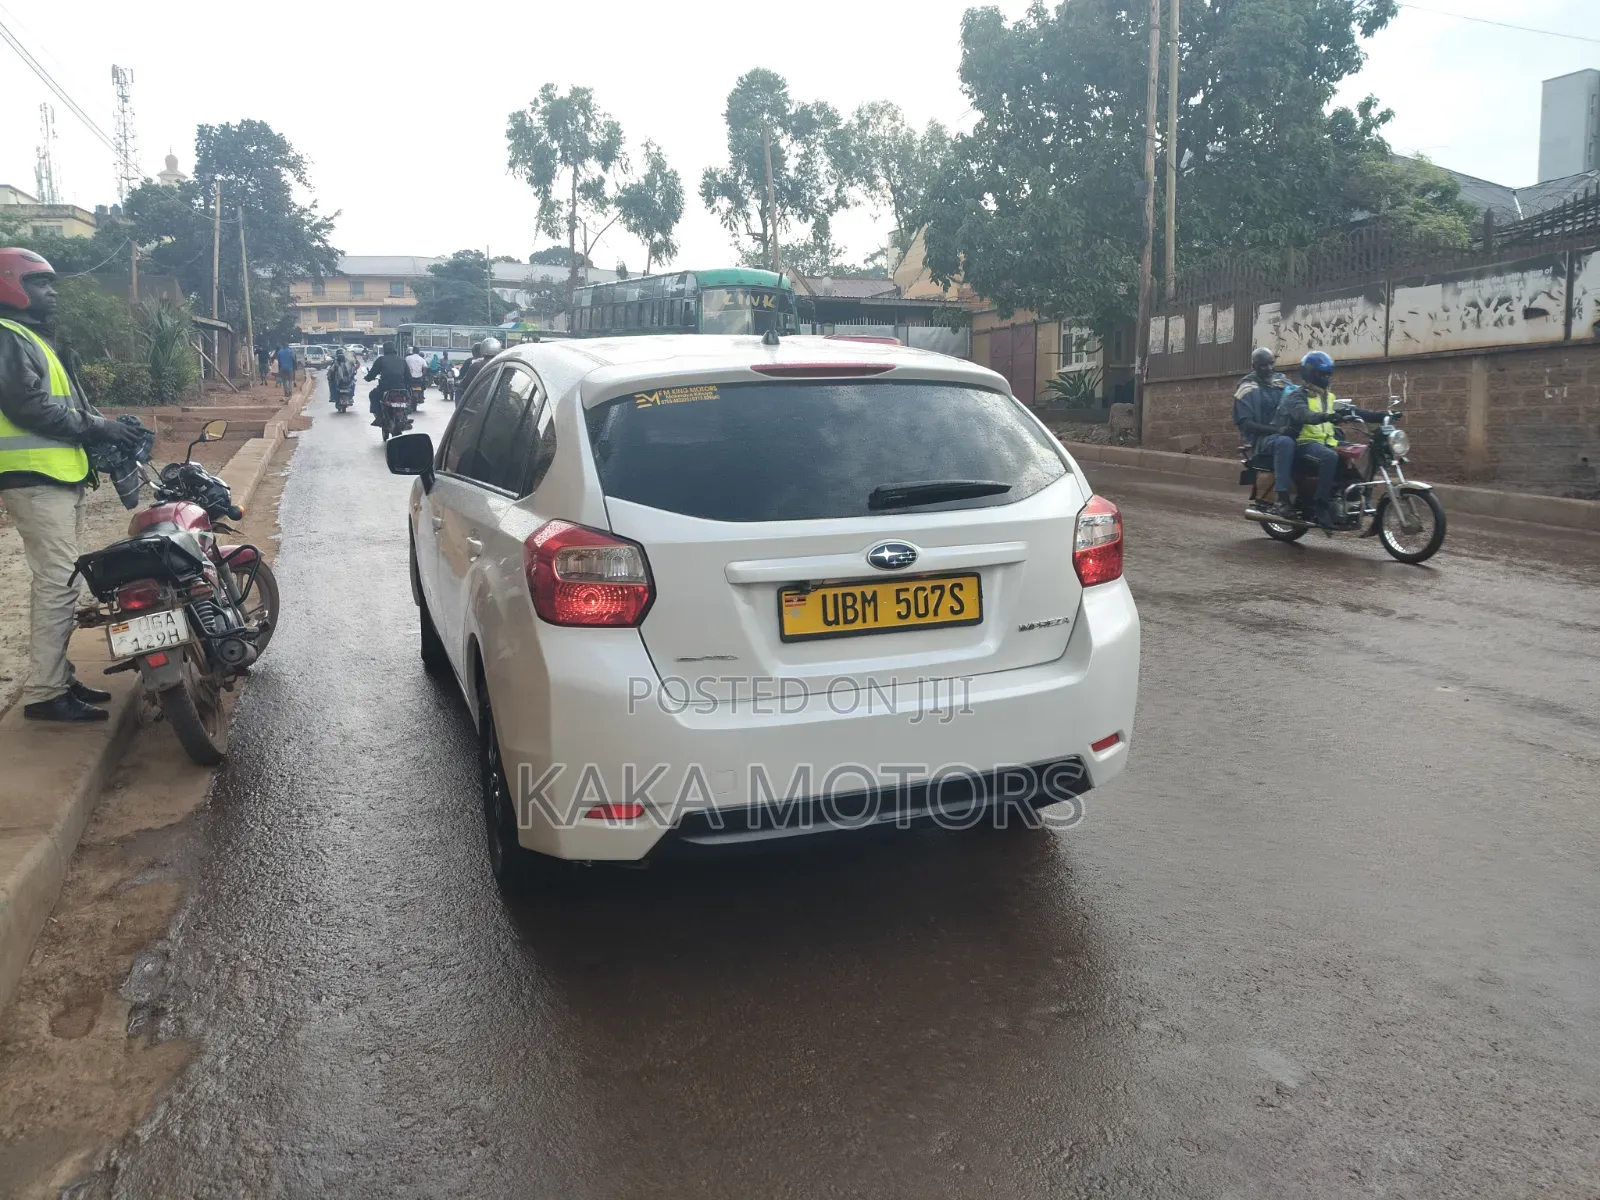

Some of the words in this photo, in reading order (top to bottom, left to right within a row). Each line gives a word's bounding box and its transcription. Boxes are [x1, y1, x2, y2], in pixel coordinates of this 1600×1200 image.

[1457, 280, 1474, 289] Start
[1491, 275, 1505, 284] day
[1506, 271, 1522, 281] with
[1544, 266, 1553, 274] of
[1358, 294, 1364, 302] of
[672, 387, 689, 395] KING
[690, 385, 718, 393] MOTORS
[822, 589, 878, 627] UBM
[895, 582, 965, 619] 507S
[138, 612, 176, 632] UGA
[1018, 616, 1070, 632] IMPREZA
[132, 628, 181, 652] 129H
